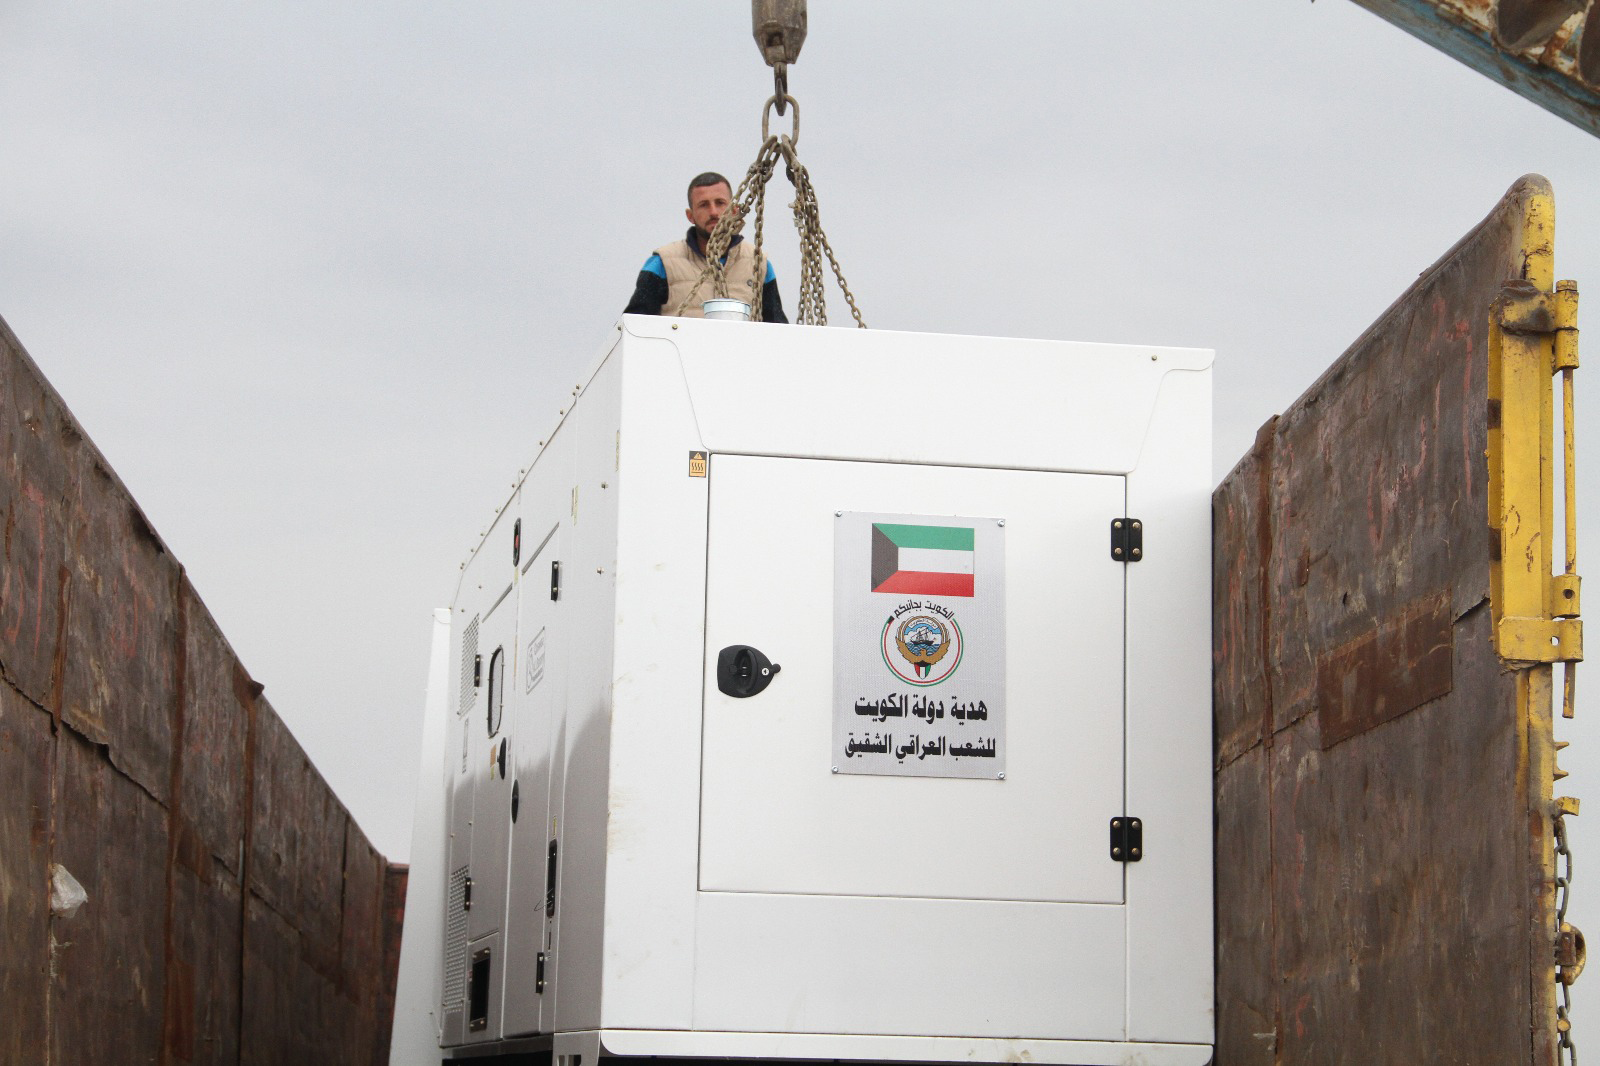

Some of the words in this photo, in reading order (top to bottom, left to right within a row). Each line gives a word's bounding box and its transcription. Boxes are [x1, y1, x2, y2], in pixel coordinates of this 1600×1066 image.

[893, 599, 922, 619] بجانبكم
[924, 600, 955, 620] الكويت
[854, 692, 908, 723] الكويت
[911, 693, 945, 724] دولة
[950, 695, 988, 726] هدية
[844, 732, 892, 758] الشقيق
[895, 734, 946, 764] العراقي
[949, 736, 996, 761] للشعب
